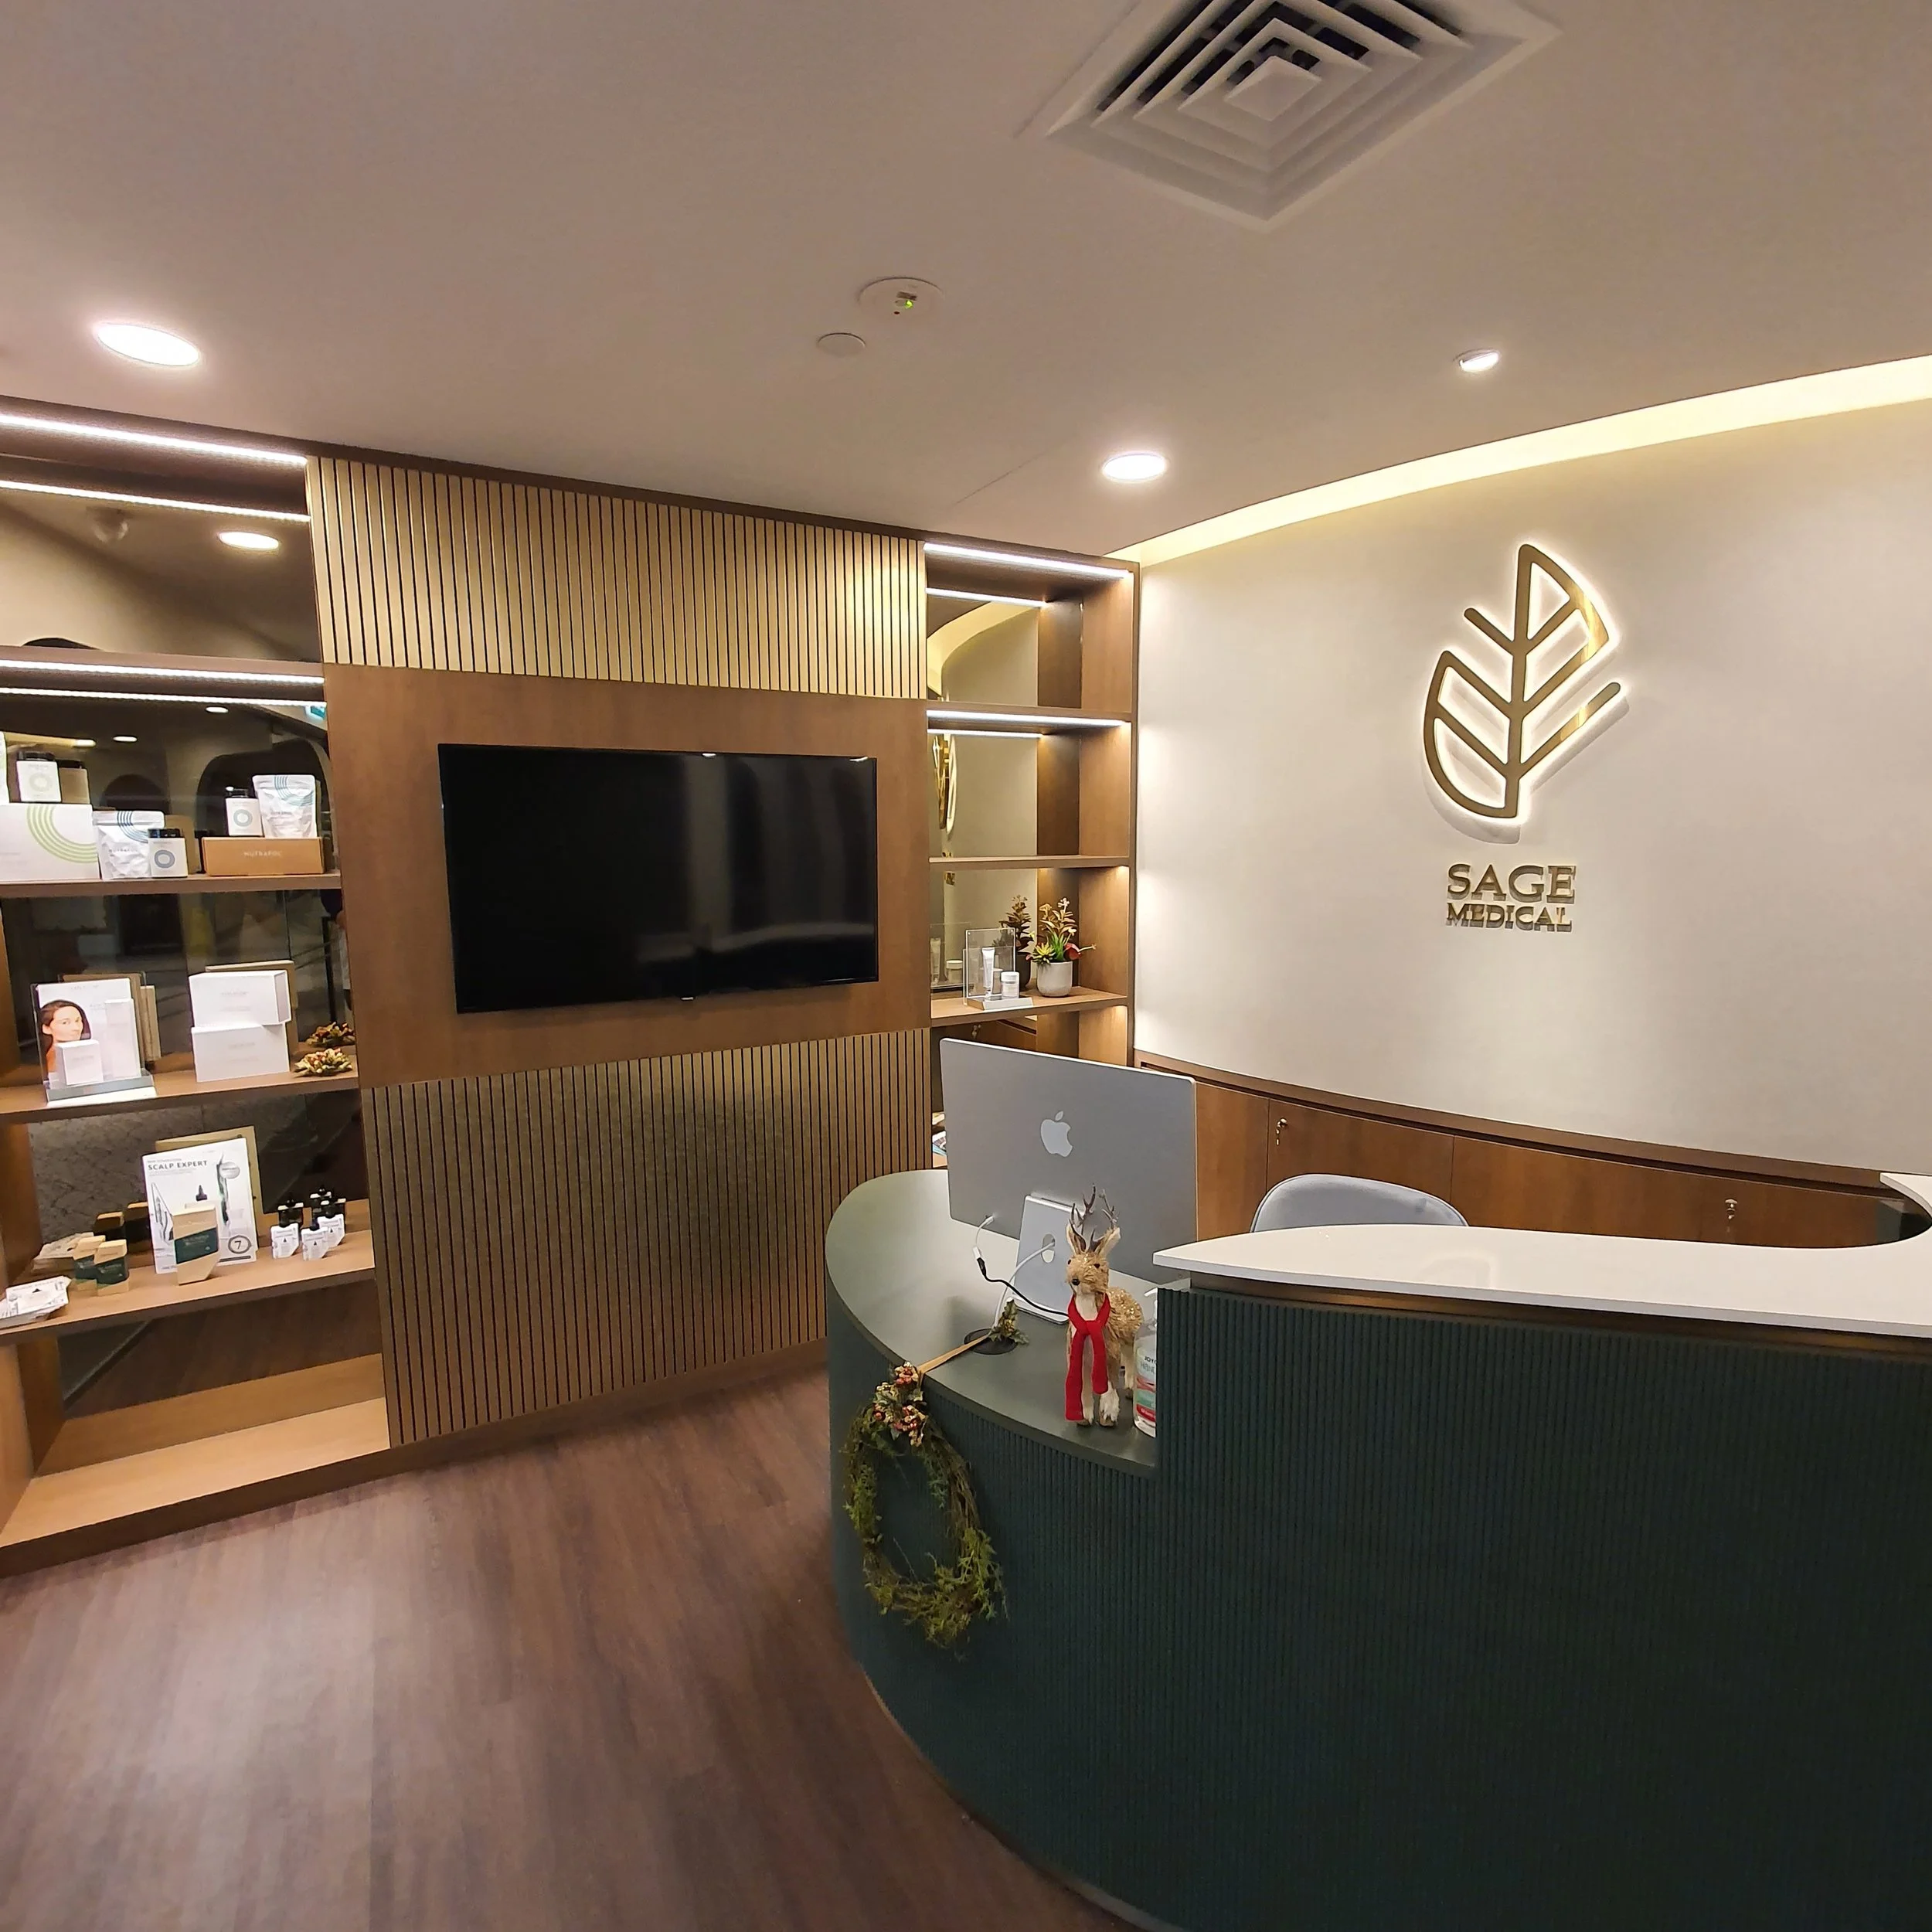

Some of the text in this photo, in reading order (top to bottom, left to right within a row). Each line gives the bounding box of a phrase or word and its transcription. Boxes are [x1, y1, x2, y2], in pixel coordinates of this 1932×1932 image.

[1447, 863, 1577, 903] SAGE
[1446, 903, 1573, 932] MEDICAL
[148, 1162, 175, 1171] SCALP
[177, 1160, 208, 1168] EXPERT
[234, 1240, 242, 1250] 7
